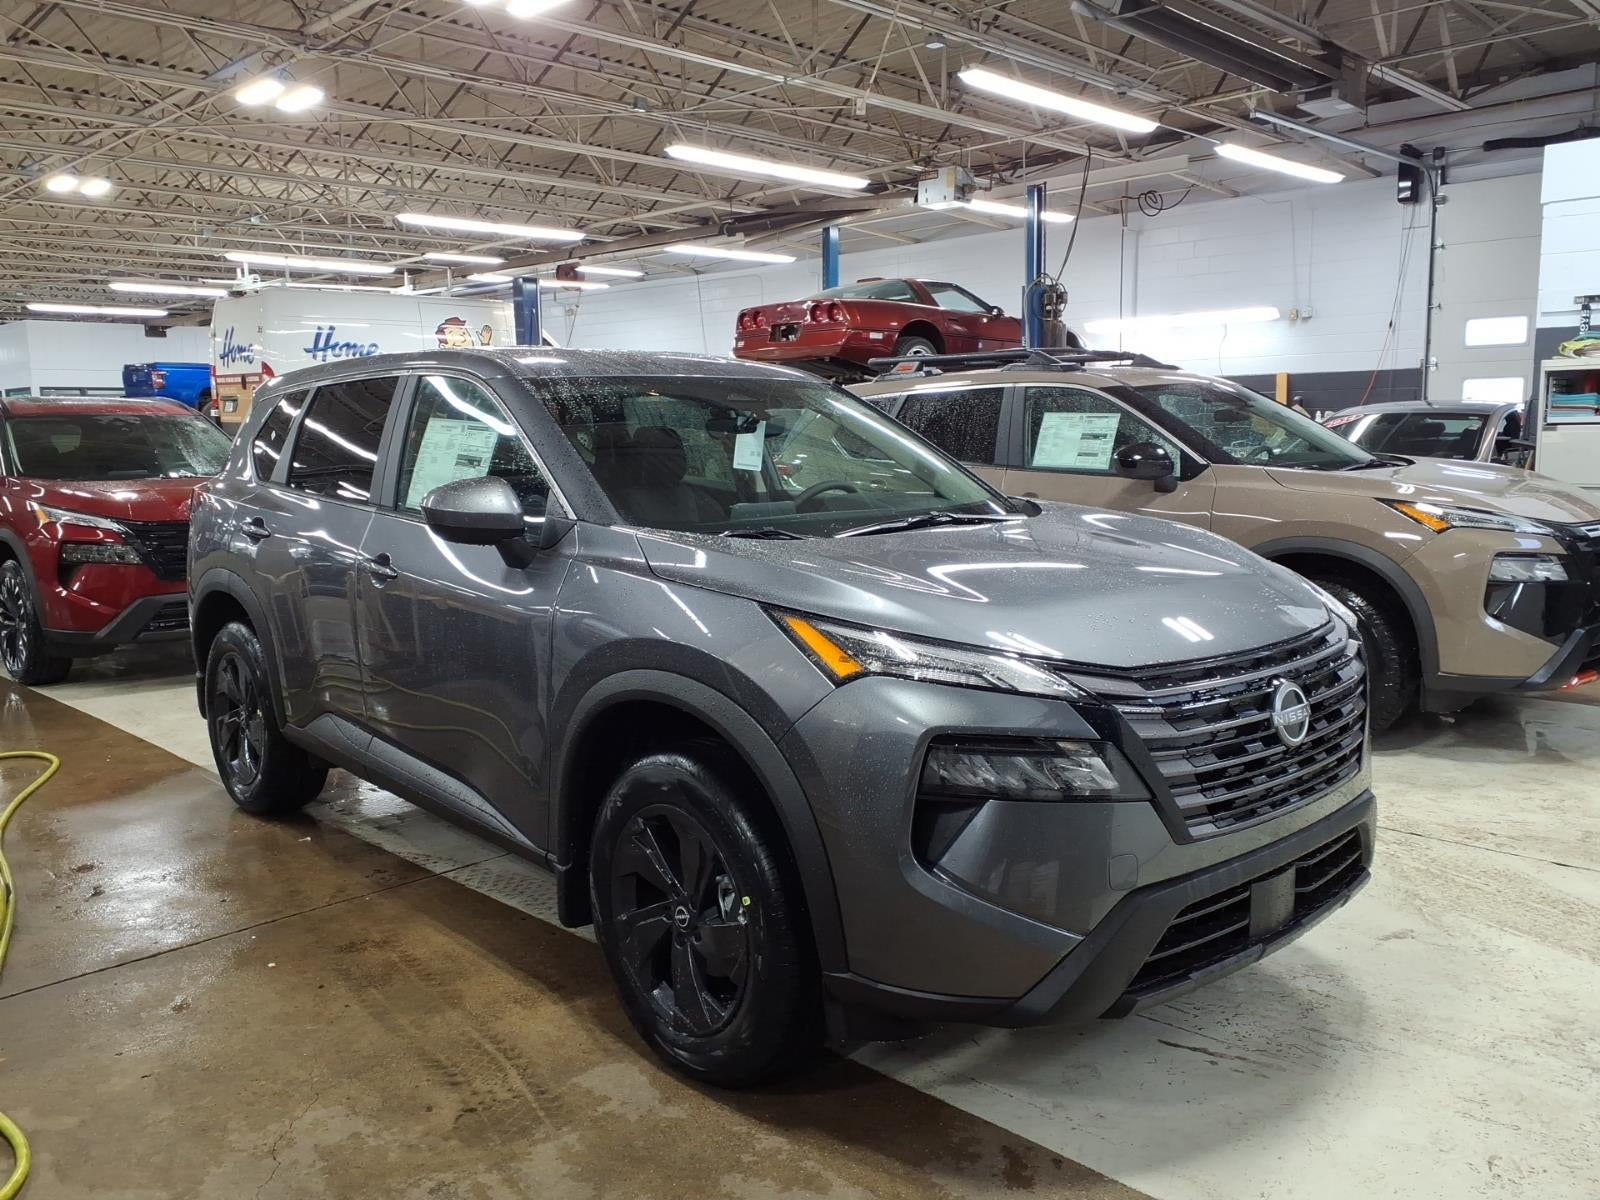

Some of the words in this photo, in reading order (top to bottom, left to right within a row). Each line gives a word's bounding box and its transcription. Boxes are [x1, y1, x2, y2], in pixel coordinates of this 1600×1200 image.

[219, 325, 256, 368] Home
[303, 325, 381, 362] Home
[1273, 703, 1311, 726] NISSAN
